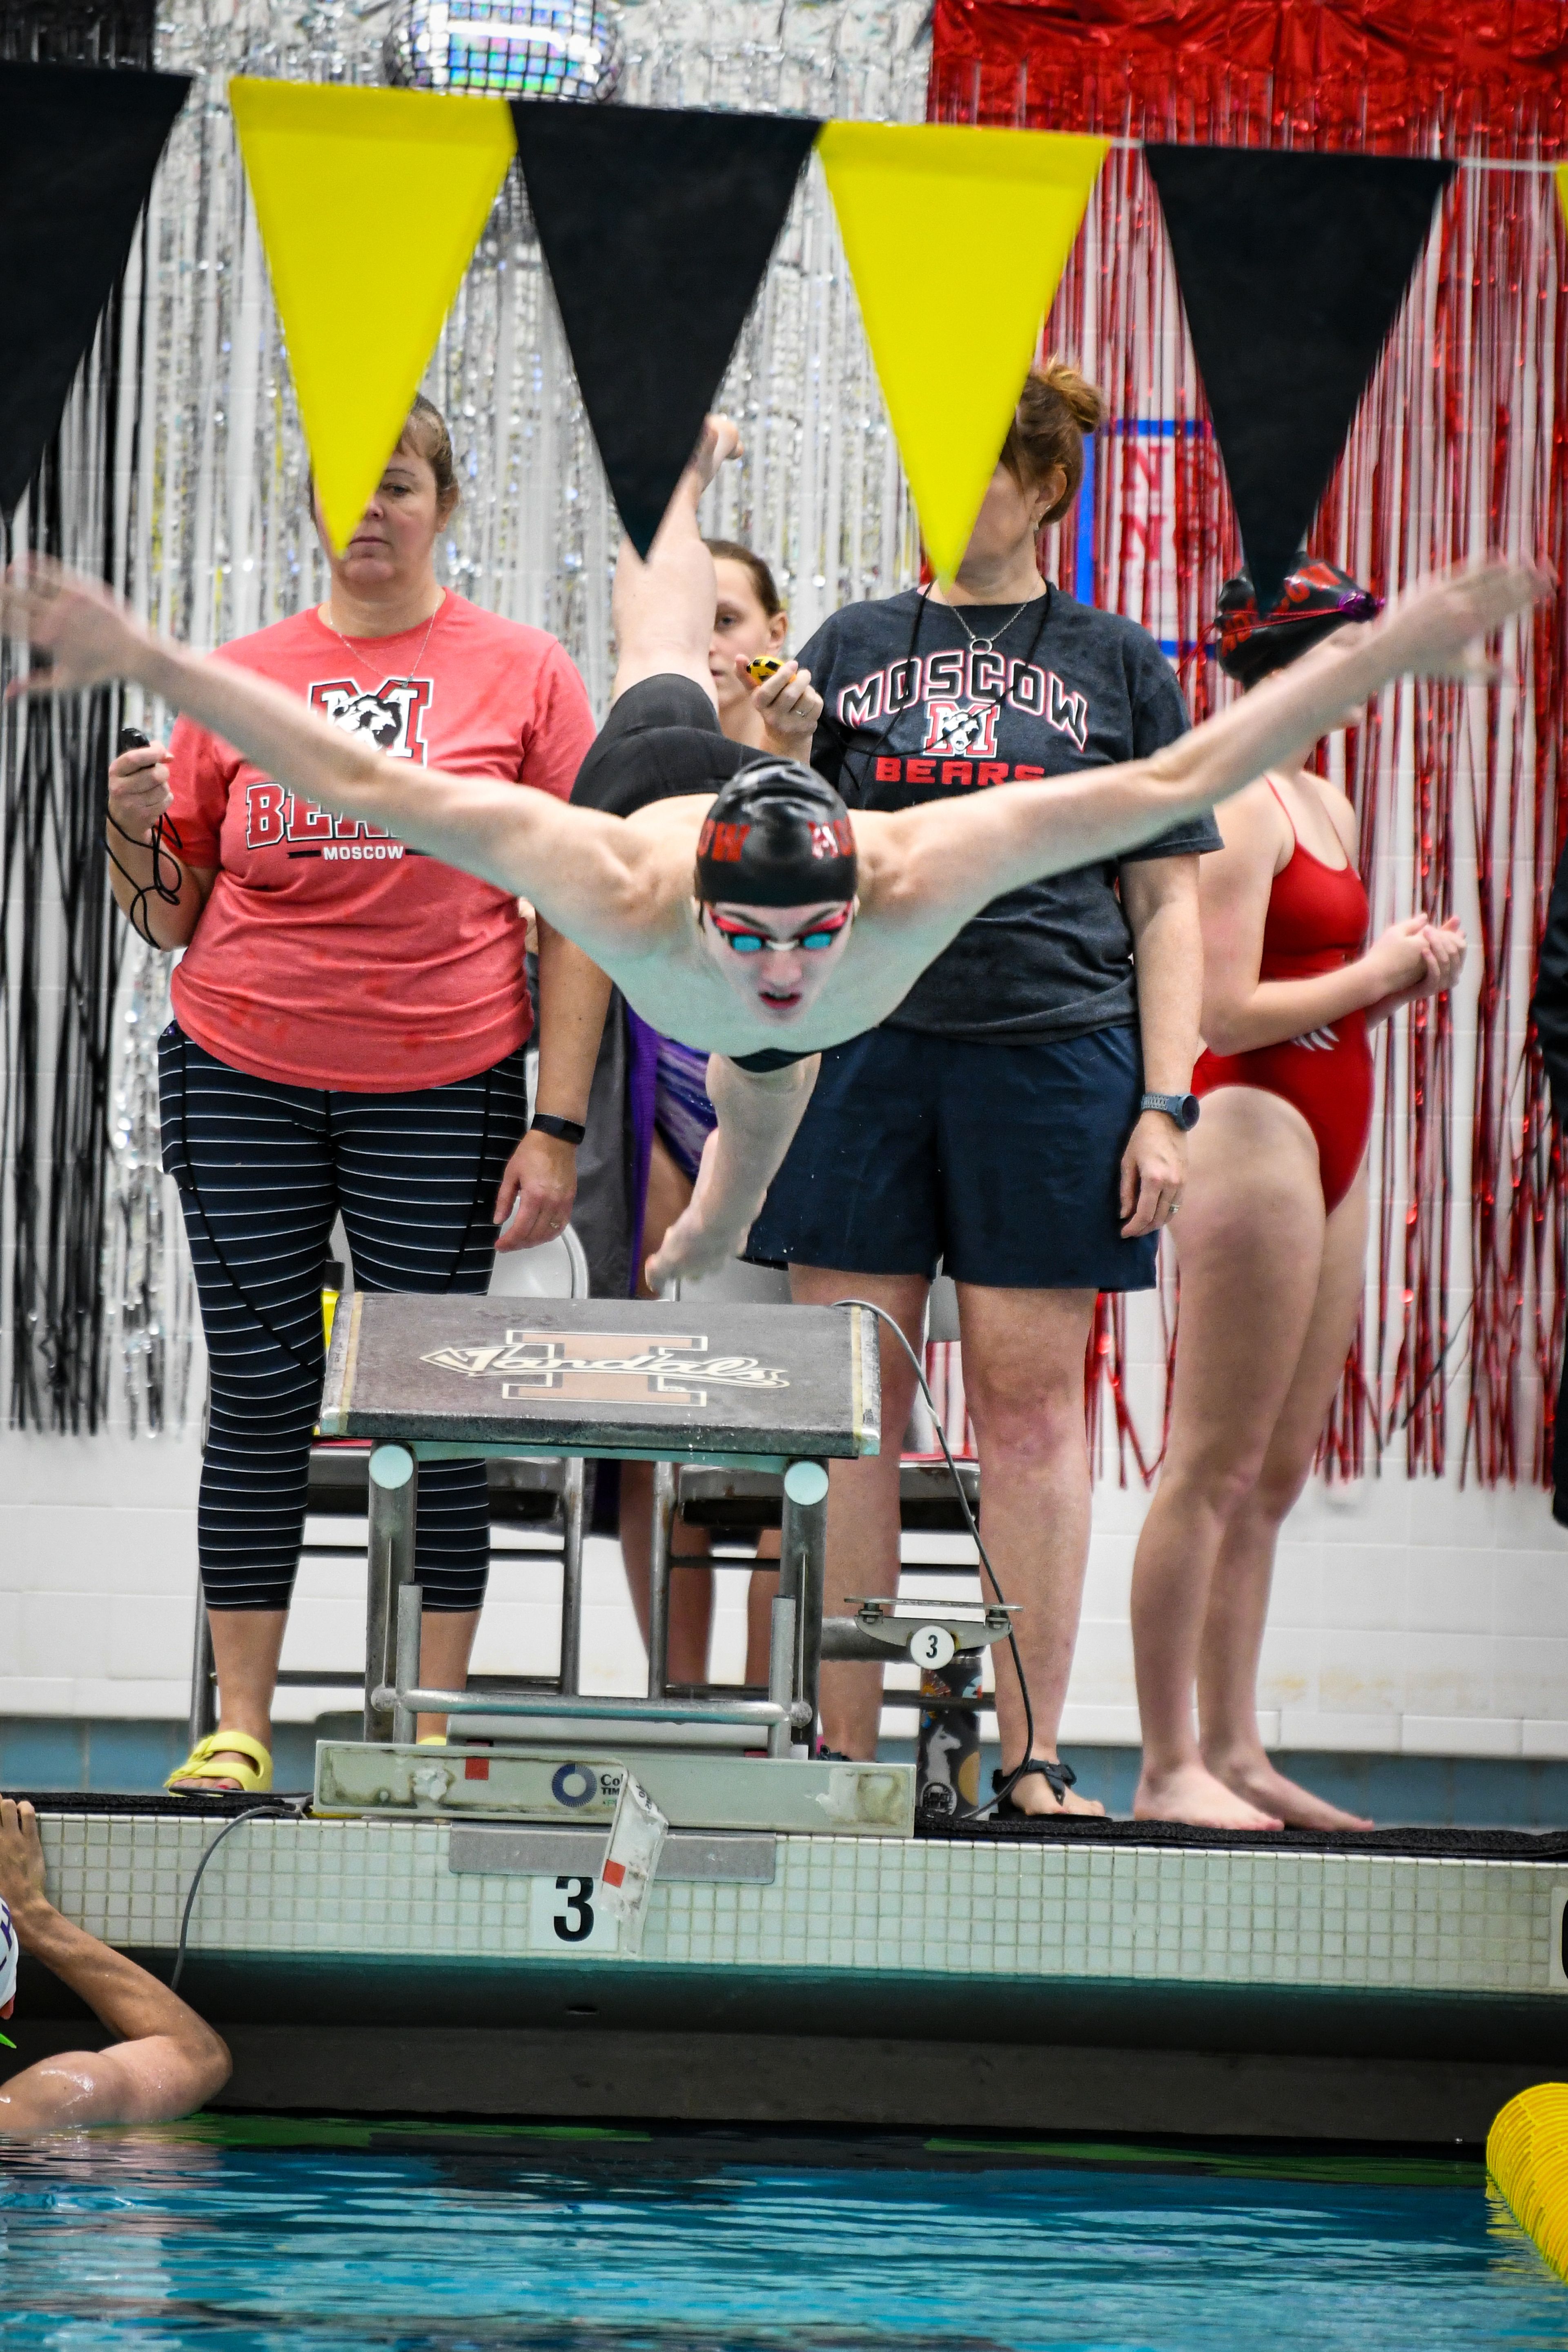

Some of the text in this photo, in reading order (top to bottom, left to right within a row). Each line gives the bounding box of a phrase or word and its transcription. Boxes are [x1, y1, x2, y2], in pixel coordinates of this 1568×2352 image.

[838, 649, 1088, 753] MOSCOW
[875, 756, 1045, 787] BEARS
[323, 845, 404, 860] MOSCOW
[419, 1346, 791, 1389] Vandals
[925, 1634, 939, 1659] 3
[552, 1876, 595, 1942] 3
